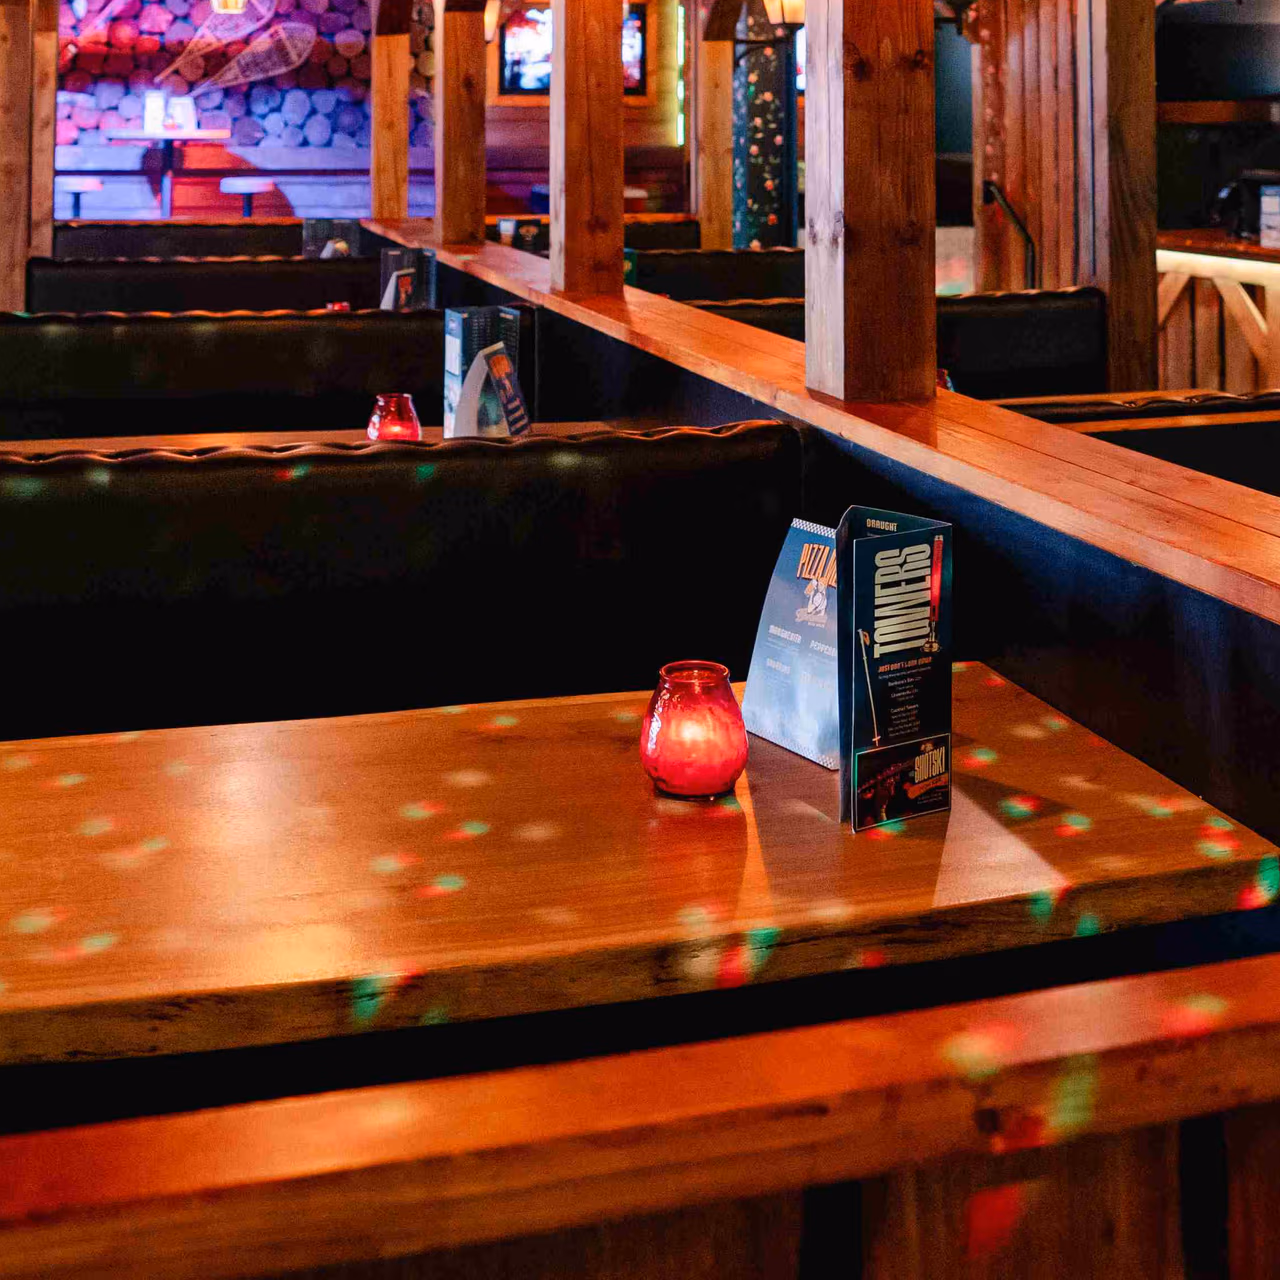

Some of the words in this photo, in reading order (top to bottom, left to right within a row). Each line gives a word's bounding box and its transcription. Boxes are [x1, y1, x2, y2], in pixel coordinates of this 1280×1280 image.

[866, 518, 898, 532] DRAUGHT
[797, 543, 830, 581] PIZZA
[874, 544, 931, 658] TOWERS
[915, 746, 945, 783] SHOTSKI
